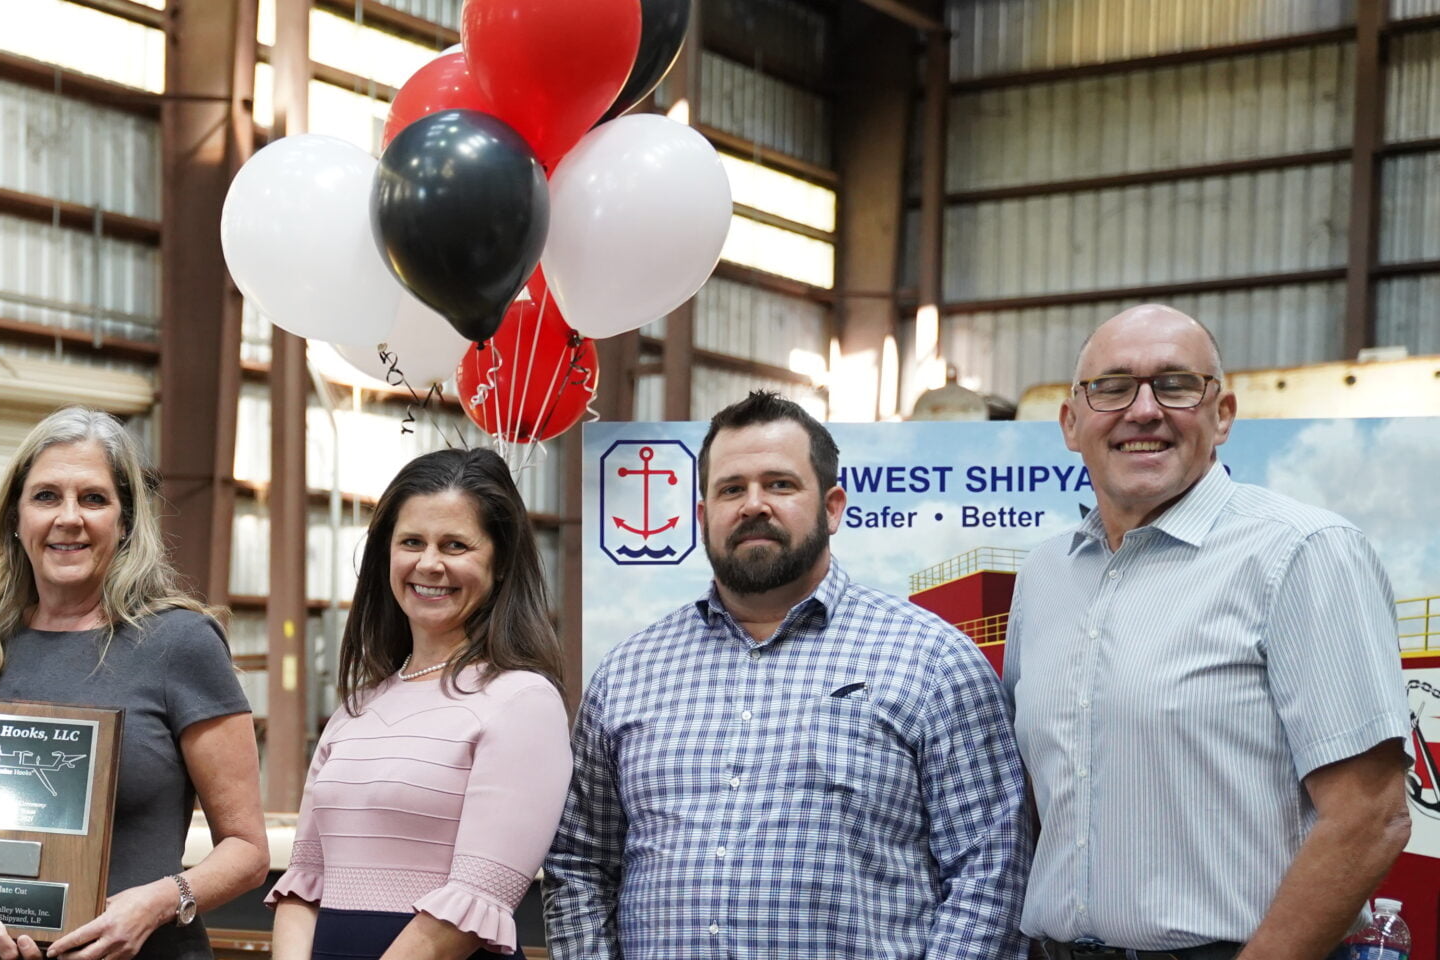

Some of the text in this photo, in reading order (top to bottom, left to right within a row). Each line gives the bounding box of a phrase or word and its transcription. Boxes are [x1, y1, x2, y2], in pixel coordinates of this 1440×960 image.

[845, 505, 1045, 528] Safer Better
[0, 725, 48, 741] Hooks,
[52, 729, 80, 741] LLC
[14, 887, 28, 895] Cut
[14, 907, 37, 916] Works,
[38, 909, 50, 917] Inc.
